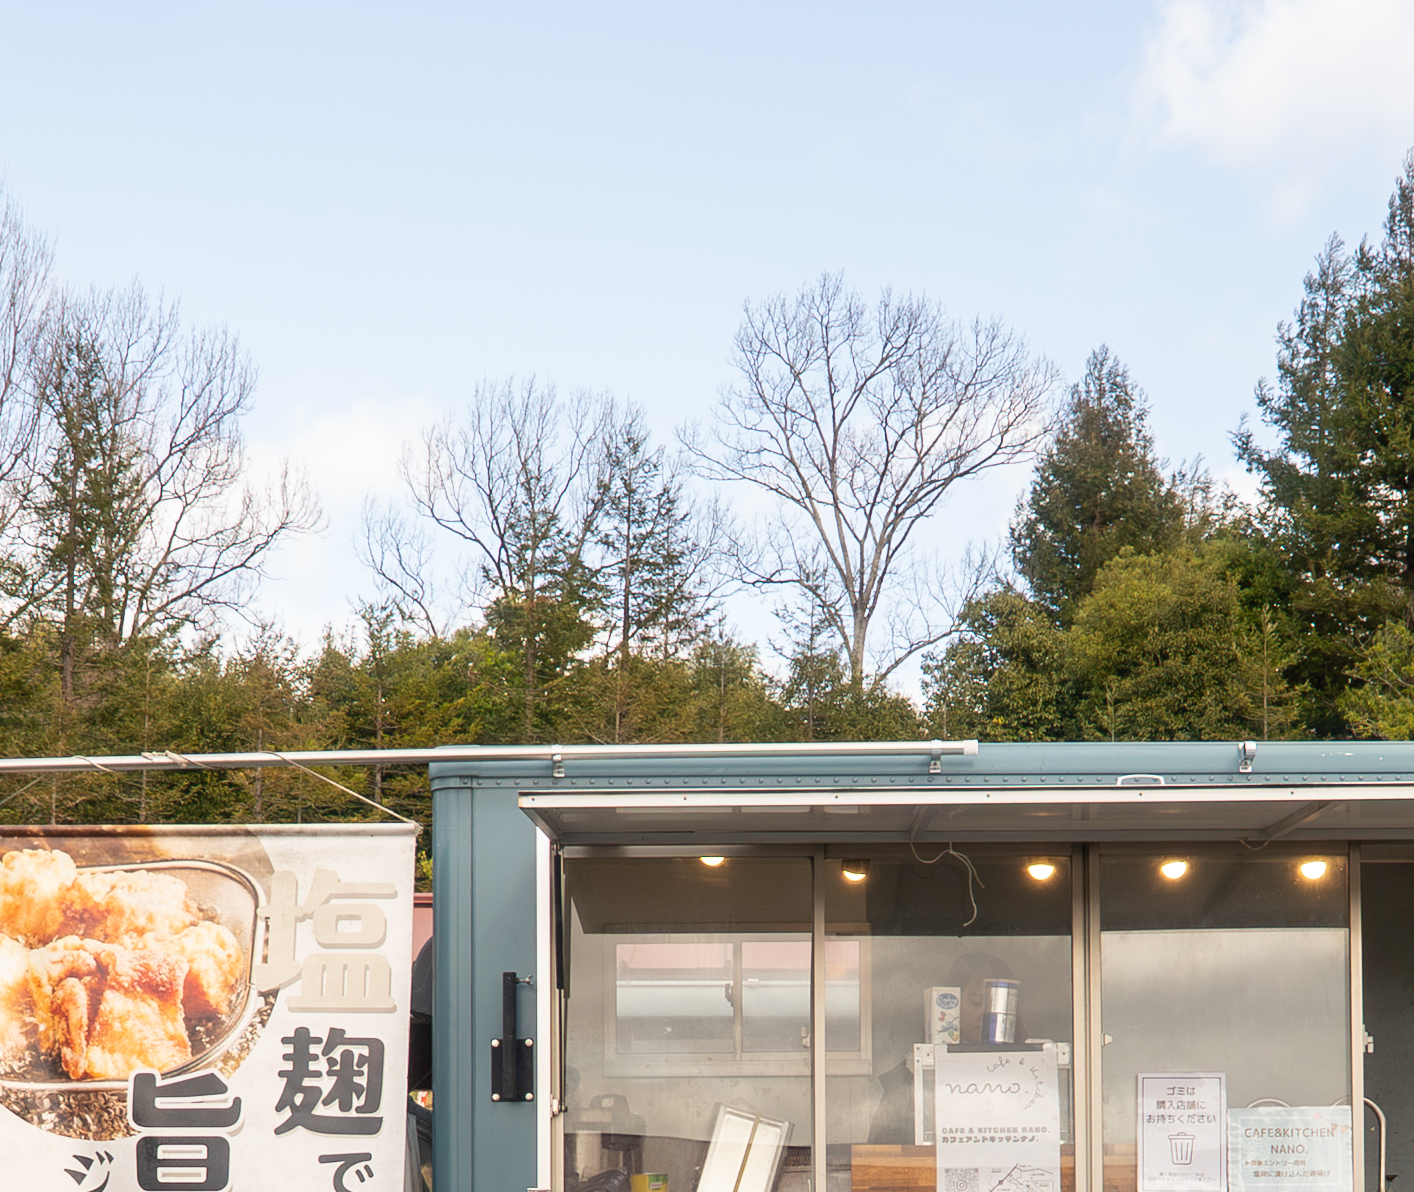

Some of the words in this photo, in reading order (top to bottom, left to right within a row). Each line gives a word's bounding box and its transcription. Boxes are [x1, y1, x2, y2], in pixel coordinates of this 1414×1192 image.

[1166, 1086, 1196, 1096] ゴミは
[1146, 1114, 1216, 1124] お持ちください
[941, 1127, 966, 1135] CAFE
[1244, 1128, 1335, 1138] CAFE&KITCHEN
[1270, 1144, 1309, 1154] NANO.
